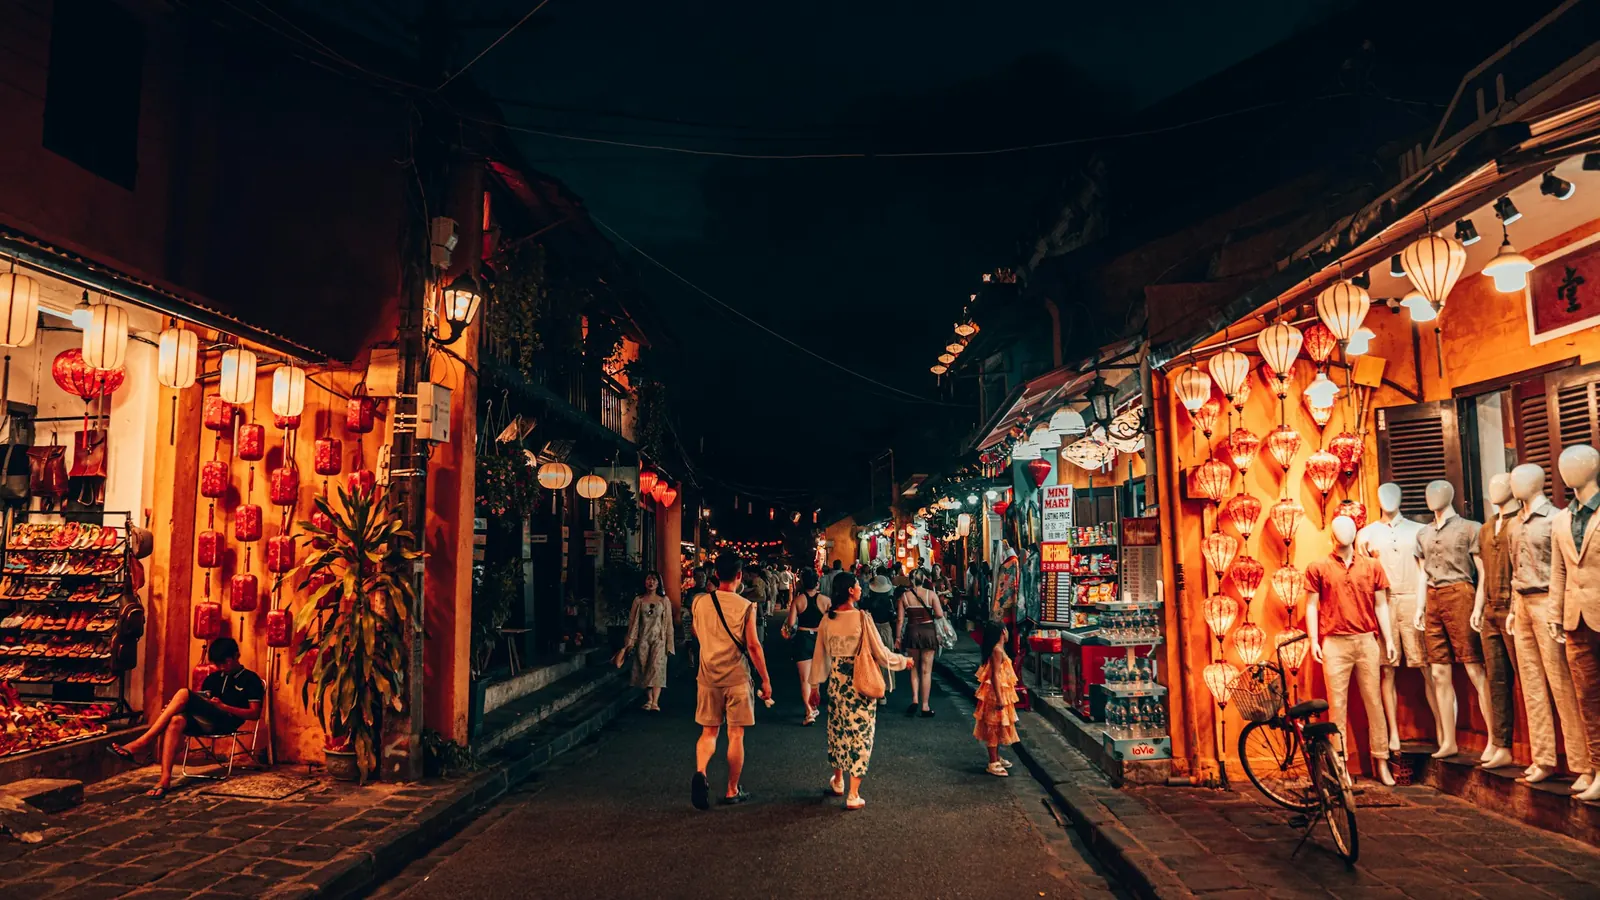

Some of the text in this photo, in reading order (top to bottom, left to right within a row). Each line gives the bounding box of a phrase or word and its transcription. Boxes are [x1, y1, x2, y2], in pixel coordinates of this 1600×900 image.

[1047, 488, 1068, 498] MINI
[1044, 498, 1070, 509] MART
[1044, 511, 1070, 520] LISTING PRICE
